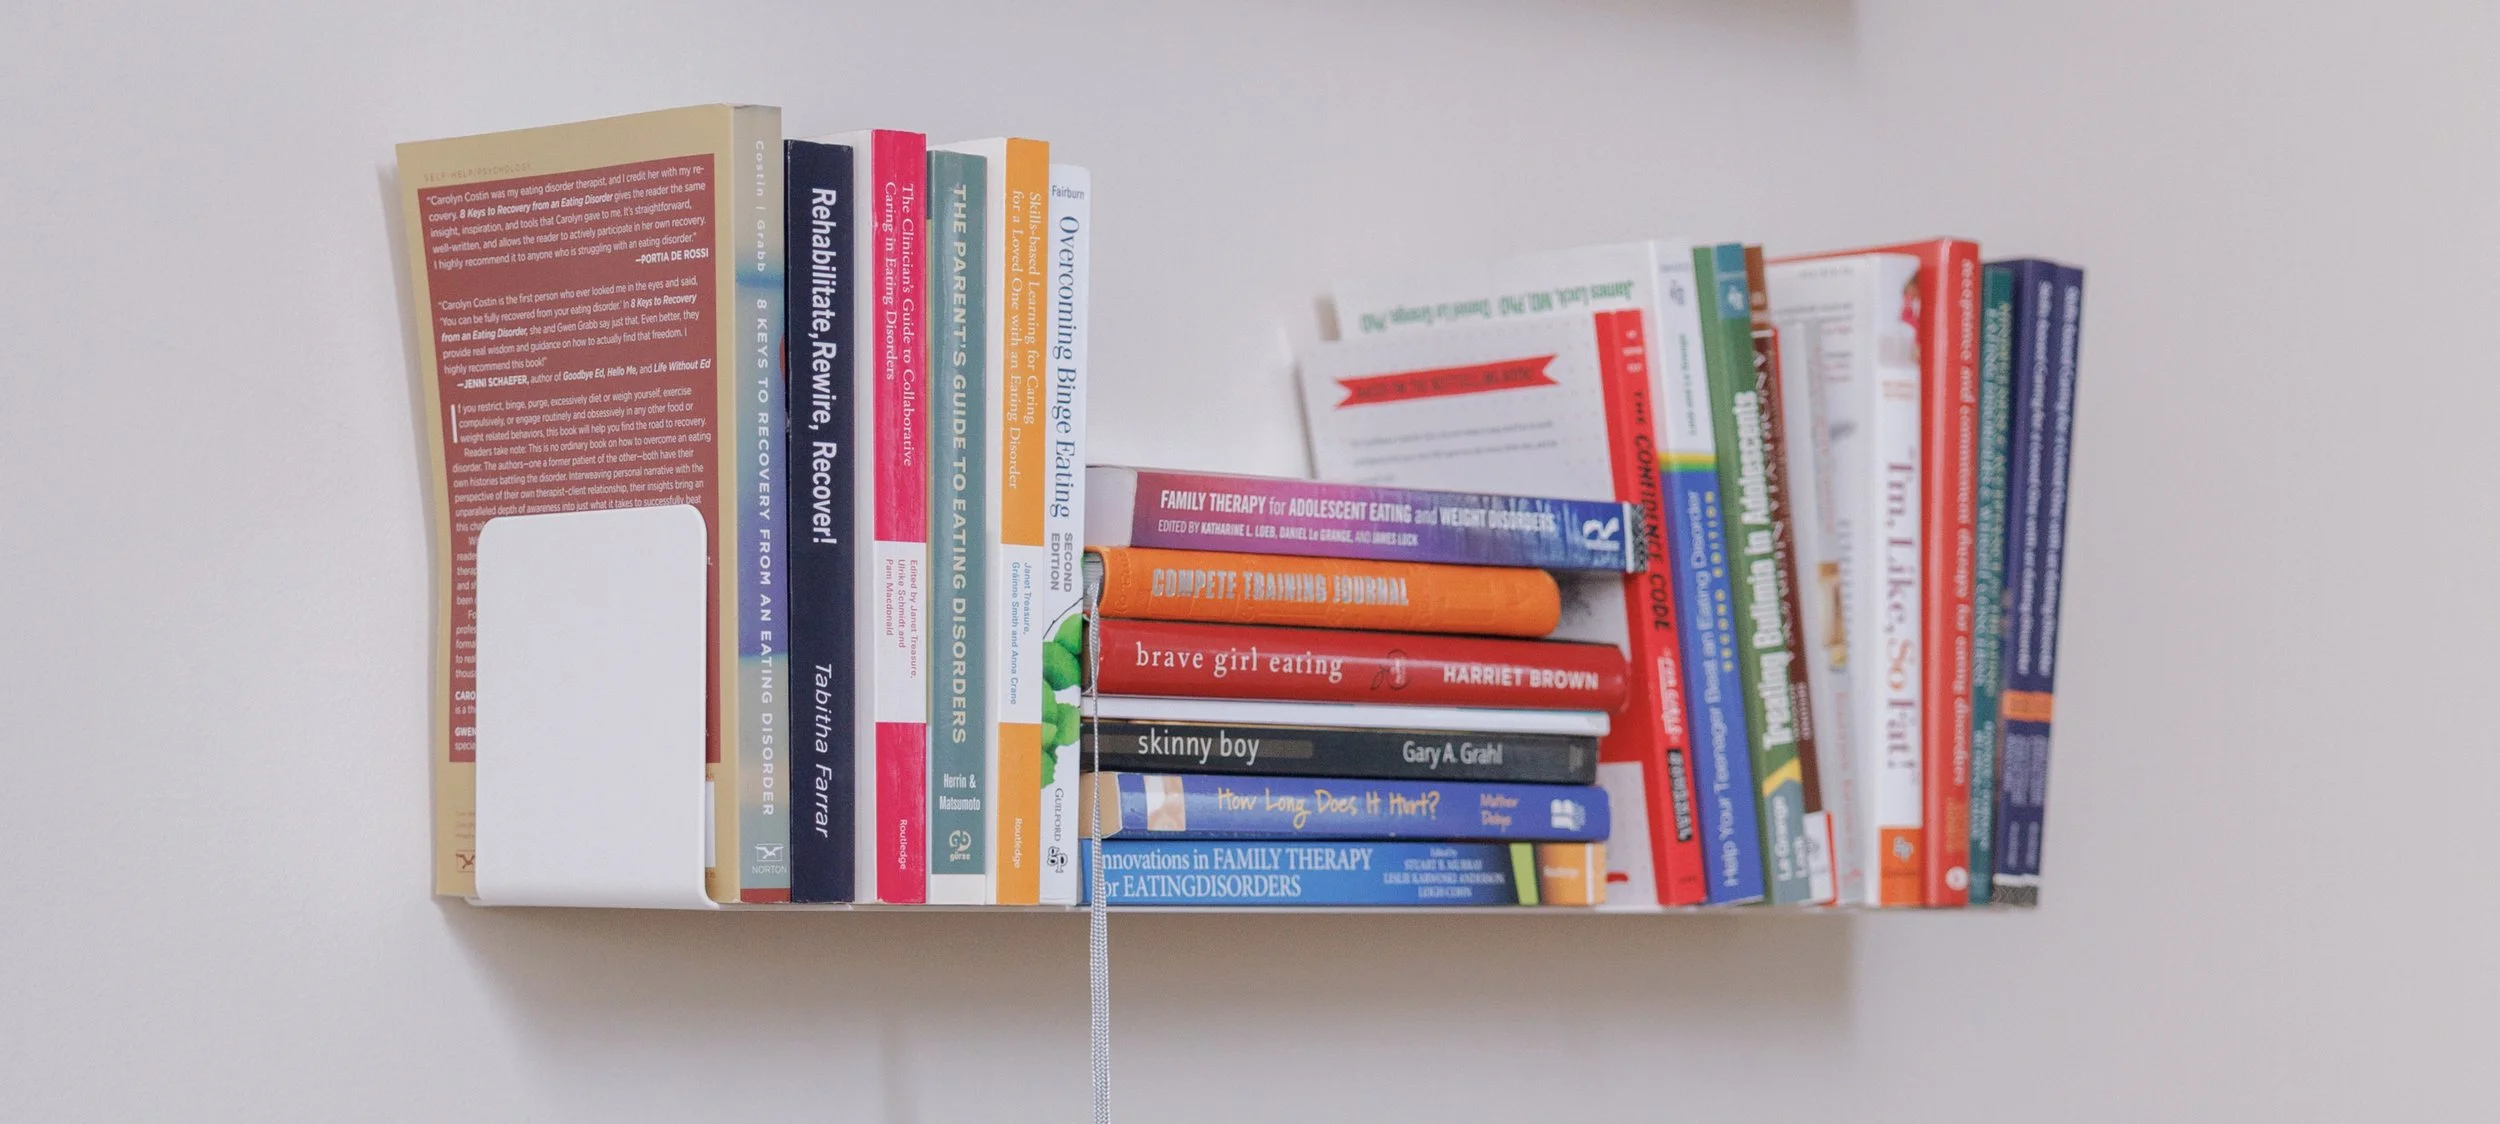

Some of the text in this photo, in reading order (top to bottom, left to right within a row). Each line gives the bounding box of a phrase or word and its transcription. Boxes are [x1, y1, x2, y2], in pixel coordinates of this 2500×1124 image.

[755, 140, 765, 196] Costin
[1052, 184, 1085, 201] Fairburn
[670, 250, 682, 261] DE
[683, 247, 708, 259] ROSSI
[756, 219, 766, 272] Grabb
[883, 181, 897, 380] Caring in Eating Disorders
[902, 183, 914, 466] The Clinician's Guide to Collaborative
[1022, 191, 1041, 424] Skills-based Learning for Caring
[1006, 190, 1024, 489] for a Loved One with an Eating Disorder
[443, 363, 467, 376] highly
[467, 359, 510, 372] recommend
[511, 358, 524, 369] this
[487, 374, 529, 387] SCHAEFER,
[530, 373, 552, 383] author
[553, 371, 561, 382] of
[562, 369, 594, 381] Goodbye
[594, 367, 605, 378] Ed,
[606, 366, 625, 377] Hello
[625, 365, 638, 375] Me,
[639, 363, 652, 374] and
[653, 361, 667, 373] Life
[668, 360, 698, 371] Without
[699, 358, 711, 369] Ed
[1049, 216, 1078, 517] Overcoming Binge Eating
[952, 183, 966, 743] THE PARENT'S GUIDE TO EATING DISORDERS
[1733, 392, 1771, 525] Adolescents
[812, 441, 837, 544] Recover!
[1160, 489, 1559, 532] FAMILY THERAPY for ADOLESCENT EATING and WEIGHT DISORDERS
[756, 298, 773, 815] 8 KEYS TO RECOVERY FROM AN EATING DISORDER
[1050, 532, 1060, 590] EDITION
[1063, 532, 1073, 592] SECOND
[1743, 530, 1773, 555] in
[885, 558, 893, 635] Pam Macdonald
[897, 559, 906, 648] Ulrike Schmidt and
[1022, 561, 1031, 635] Janet Treasure,
[1151, 568, 1409, 605] COMPETE TRAINING JOURNAL
[1745, 559, 1783, 649] Bulimia
[908, 559, 918, 678] Edited by Janet Treasure,
[1010, 629, 1018, 647] and
[1011, 600, 1019, 627] Smith
[1010, 649, 1018, 674] Anna
[1135, 640, 1344, 683] brave girl eating
[1443, 664, 1598, 689] HARRIET BROWN
[1009, 676, 1018, 704] Crane
[1687, 490, 1739, 887] Help Your Teenager Beat an Eating Disorder
[1755, 651, 1793, 750] Treating
[815, 663, 832, 838] Tabitha Farrar
[1138, 727, 1259, 766] skinny boy
[1402, 740, 1502, 770] Gary A. Grahl
[939, 796, 981, 811] Matsumoto
[944, 773, 976, 789] Herrin &
[1217, 786, 1440, 828] How Long Does It Hurt?
[1053, 787, 1064, 842] GUILFORD
[897, 819, 907, 870] Routledge
[1011, 817, 1022, 868] Routledge
[1100, 847, 1373, 872] nnovations in FAMILY THERAPY
[752, 864, 787, 874] NORTON
